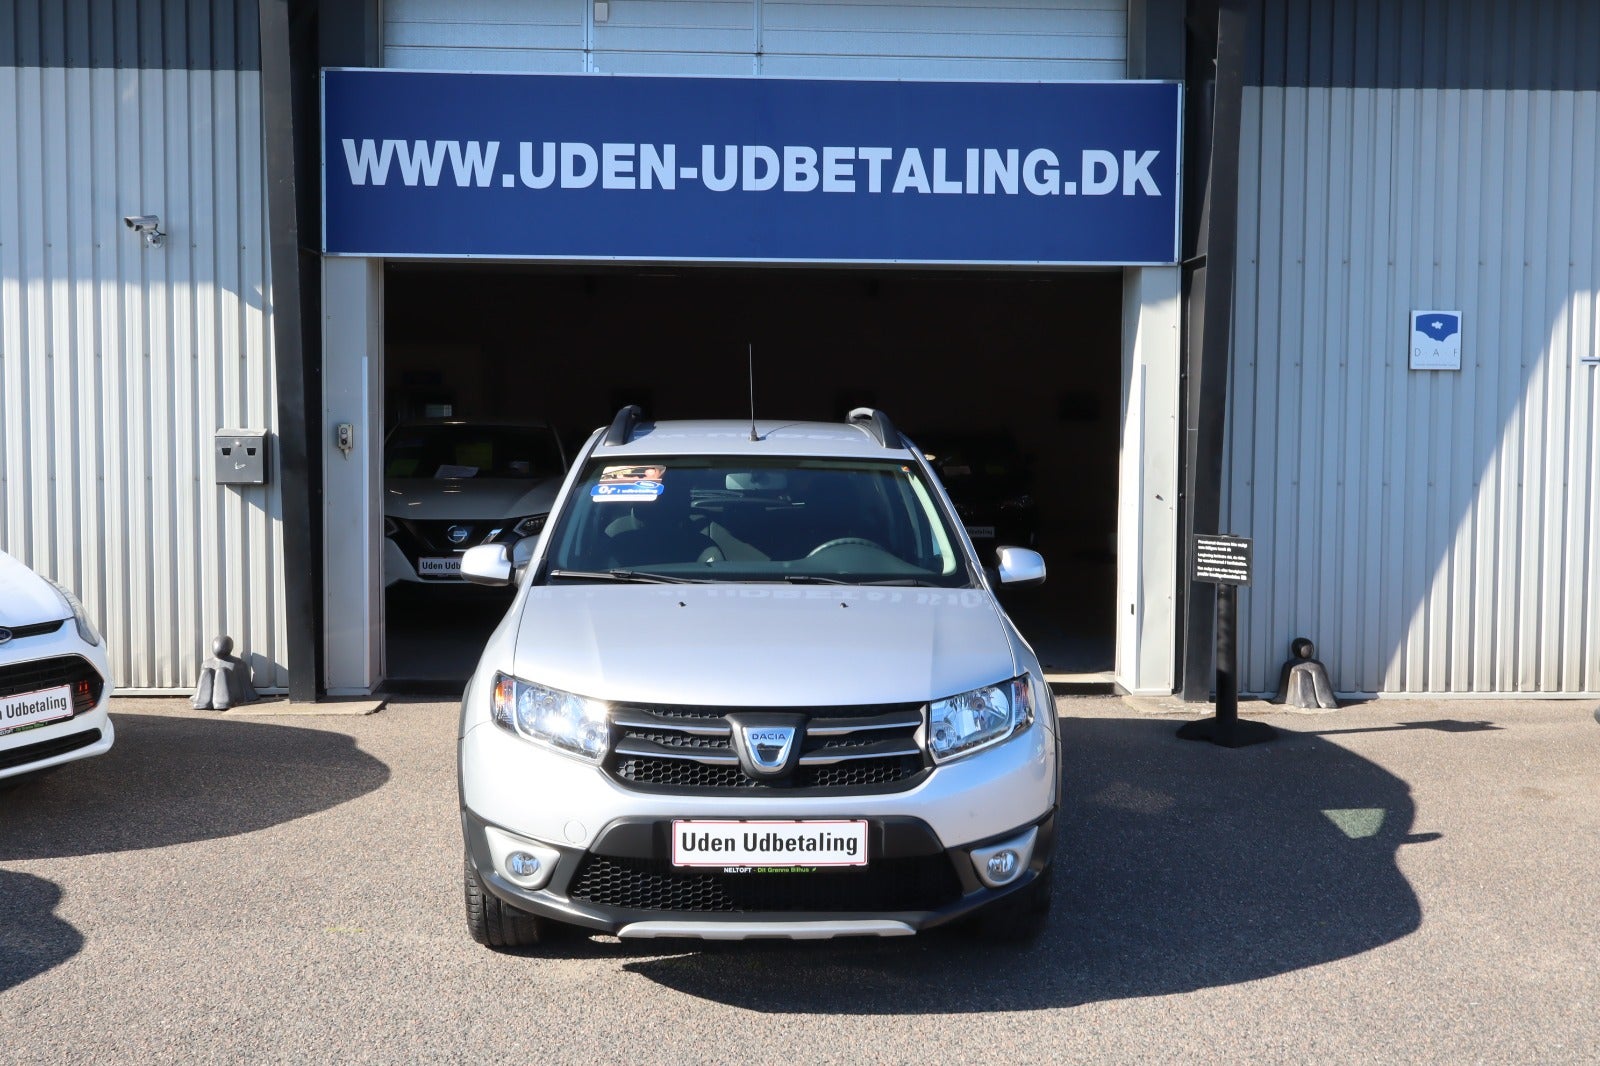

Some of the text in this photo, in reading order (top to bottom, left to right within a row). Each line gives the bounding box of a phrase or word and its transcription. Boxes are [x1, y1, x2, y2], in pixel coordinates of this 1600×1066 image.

[342, 139, 1161, 196] WWW.UDEN-UDBETALING.DK
[422, 561, 443, 570] Uden
[6, 696, 67, 719] Udbetaling
[682, 832, 858, 856] Uden Udbetaling
